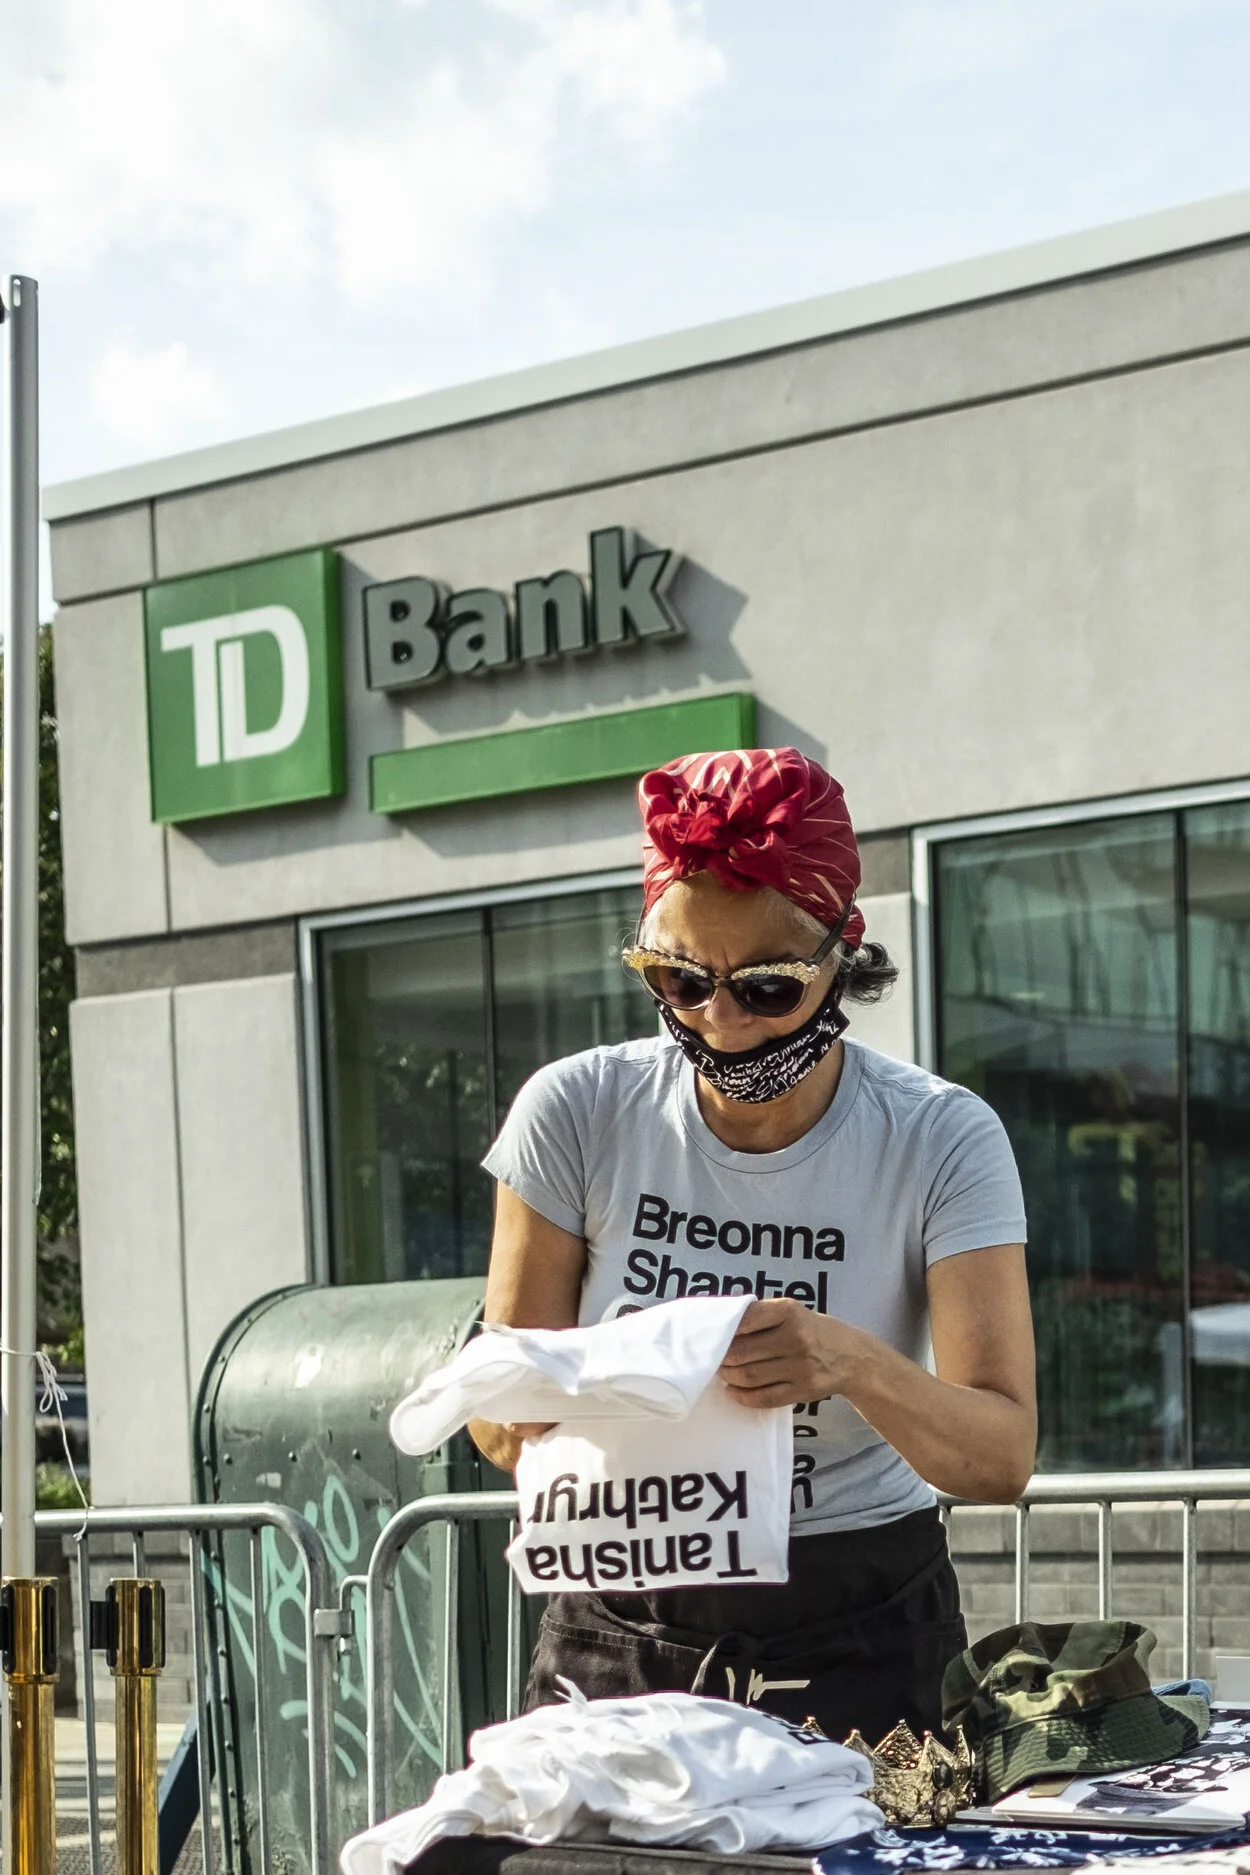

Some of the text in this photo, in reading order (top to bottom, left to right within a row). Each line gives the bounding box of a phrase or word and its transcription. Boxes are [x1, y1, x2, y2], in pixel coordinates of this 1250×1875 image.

[161, 527, 686, 767] TD Bank
[633, 1193, 845, 1262] Breonna
[525, 1530, 758, 1589] Tanisha
